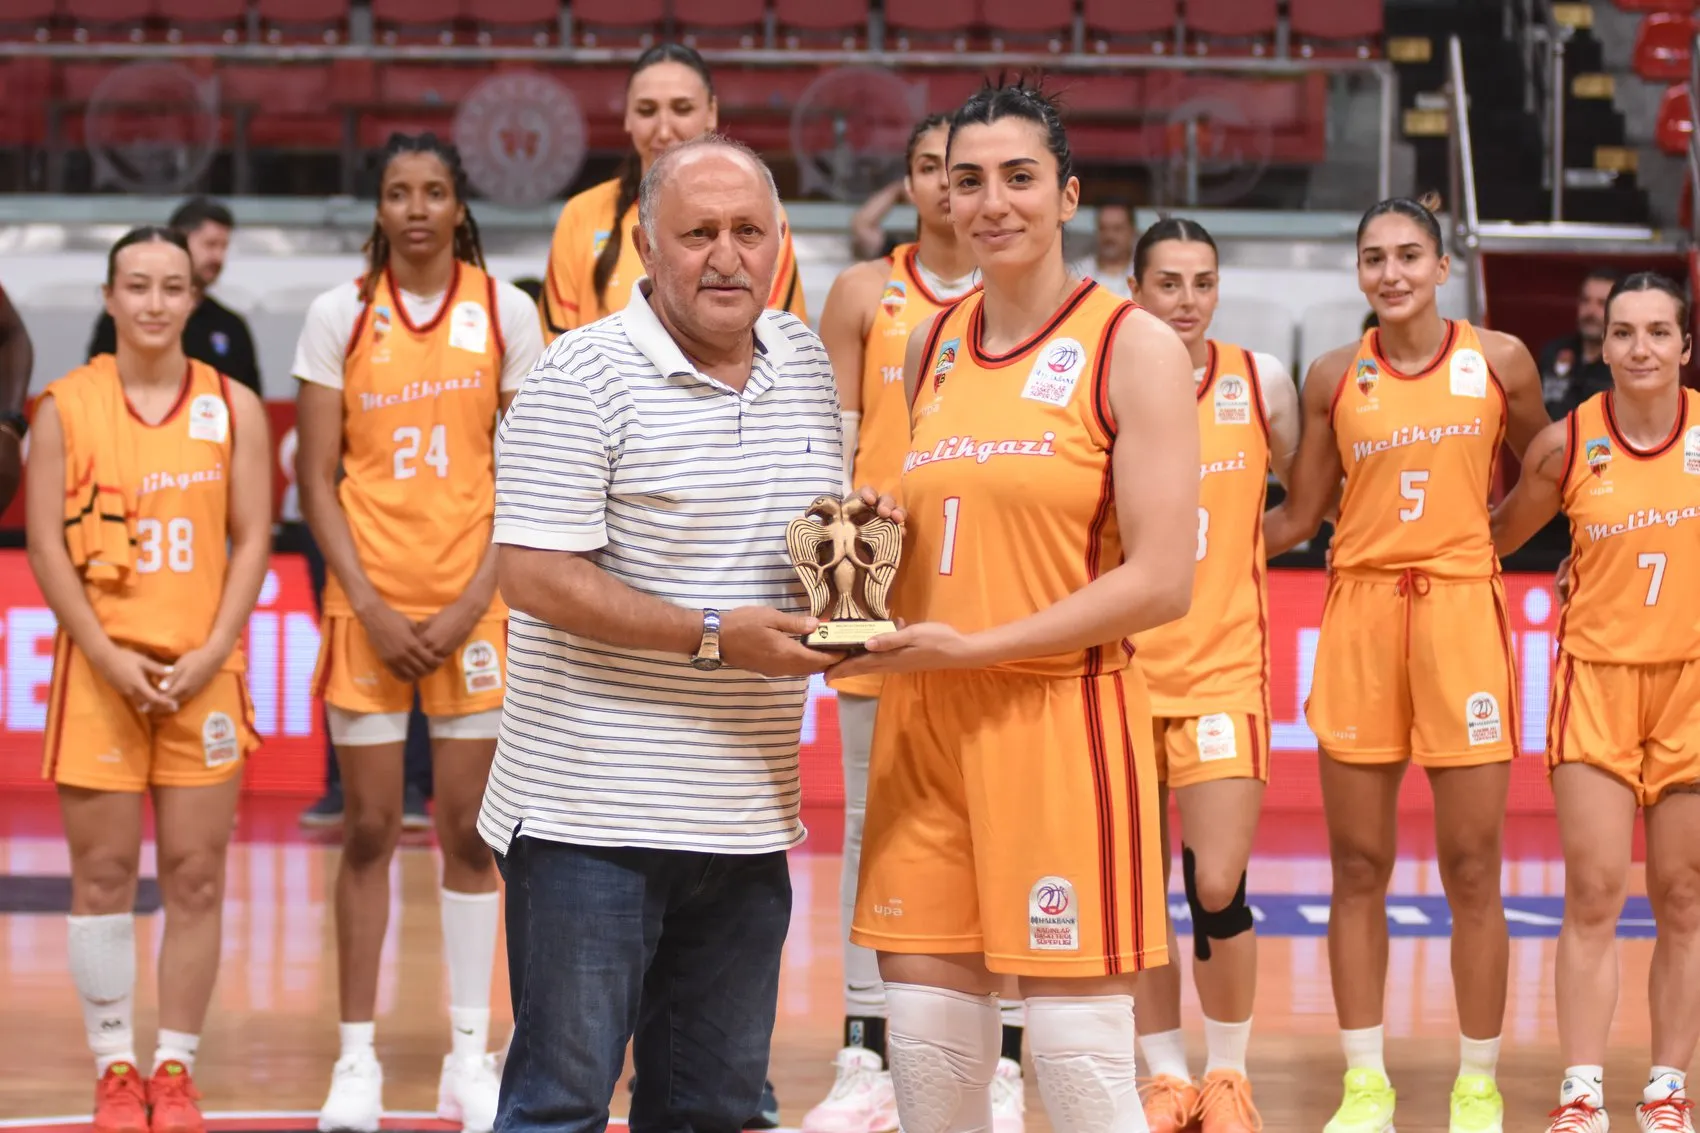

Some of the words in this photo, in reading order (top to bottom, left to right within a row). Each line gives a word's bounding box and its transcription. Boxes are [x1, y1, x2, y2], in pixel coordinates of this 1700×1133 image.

[392, 424, 449, 480] 24
[1352, 418, 1482, 463] Melikgazi
[1399, 469, 1430, 523] 5
[136, 516, 194, 573] 38
[939, 495, 961, 577] 1
[1585, 505, 1700, 543] Melikga
[1636, 552, 1668, 607] 7
[873, 904, 903, 917] upa
